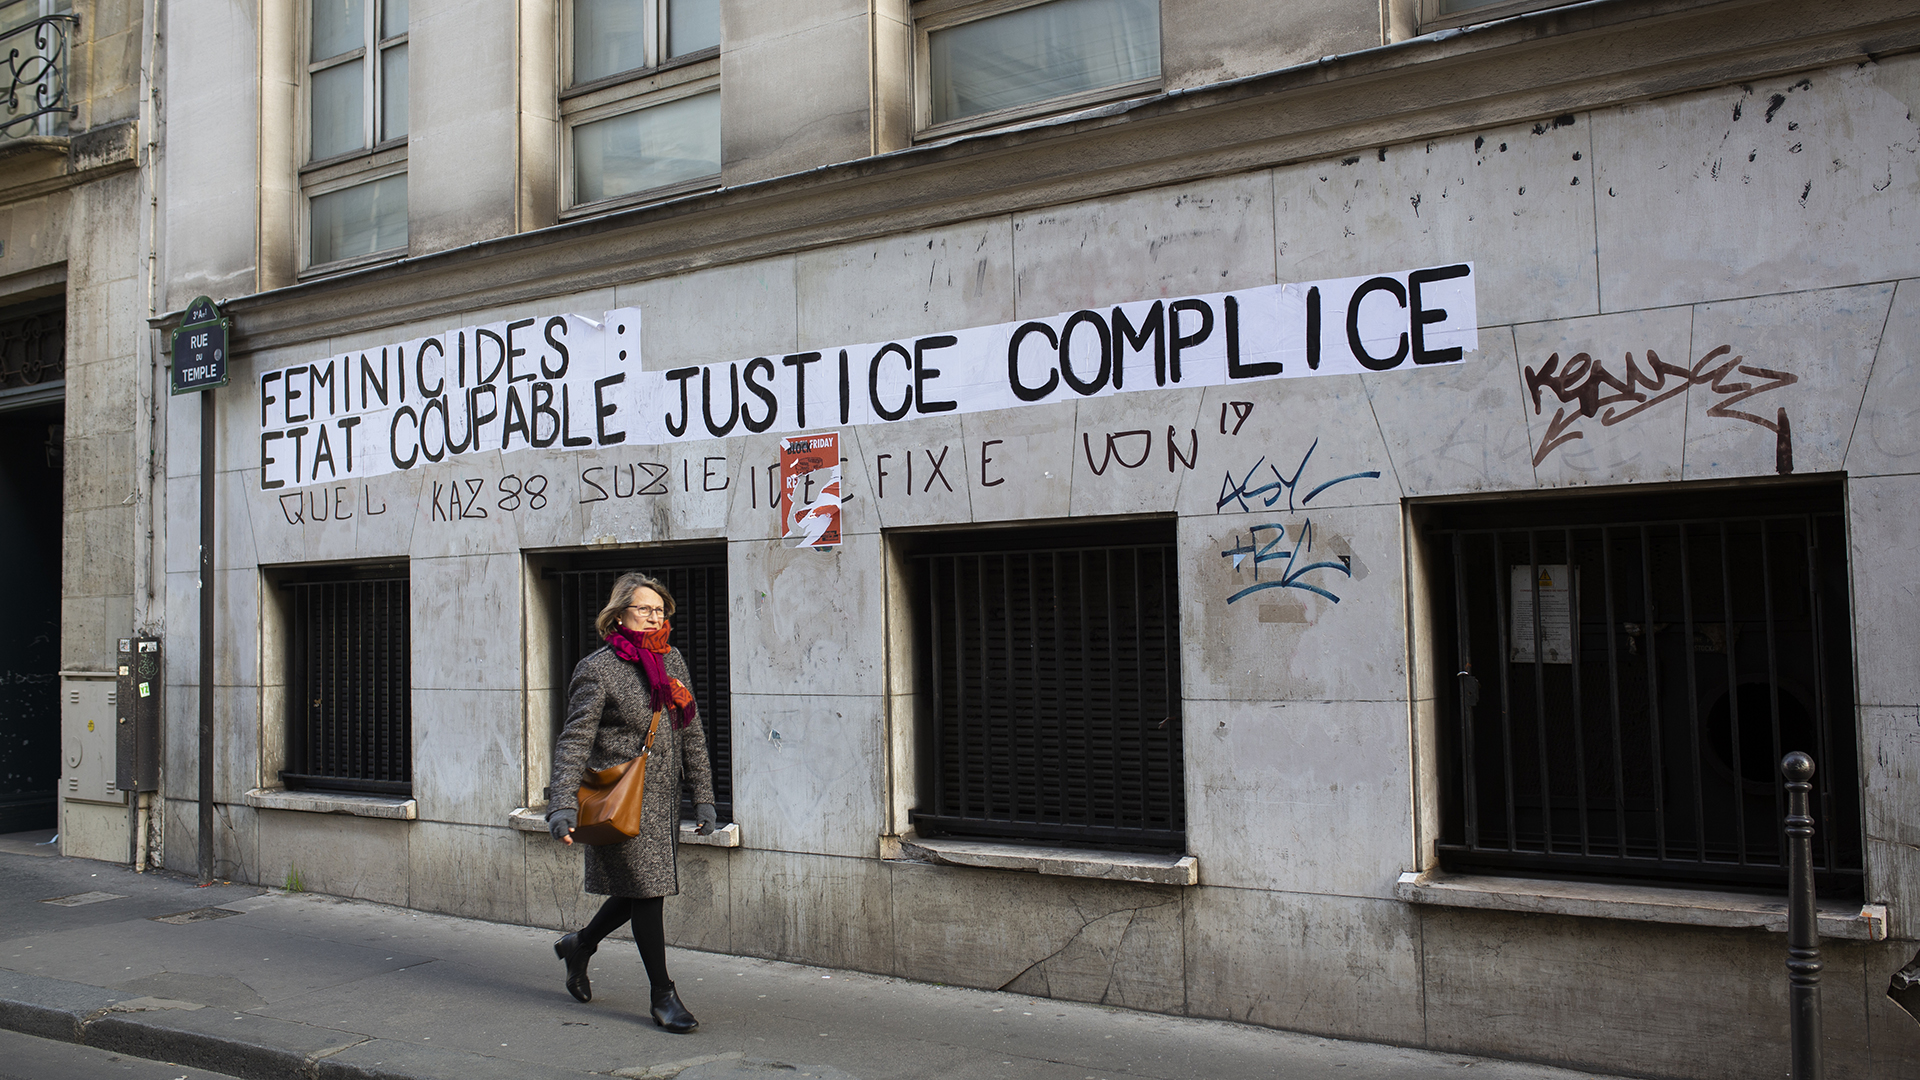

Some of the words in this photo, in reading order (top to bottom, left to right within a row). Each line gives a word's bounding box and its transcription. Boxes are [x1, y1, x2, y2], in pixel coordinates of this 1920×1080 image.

[190, 333, 208, 349] RUE
[195, 353, 203, 361] DU
[182, 363, 217, 382] TEMPLE
[261, 316, 569, 427] FEMINICIDES
[261, 416, 361, 490] ETAT
[390, 372, 626, 470] COUPABLE
[665, 336, 958, 438] JUSTICE
[1007, 264, 1471, 401] COMPLICE
[809, 437, 834, 449] FRIDAY
[279, 486, 386, 525] QUEL
